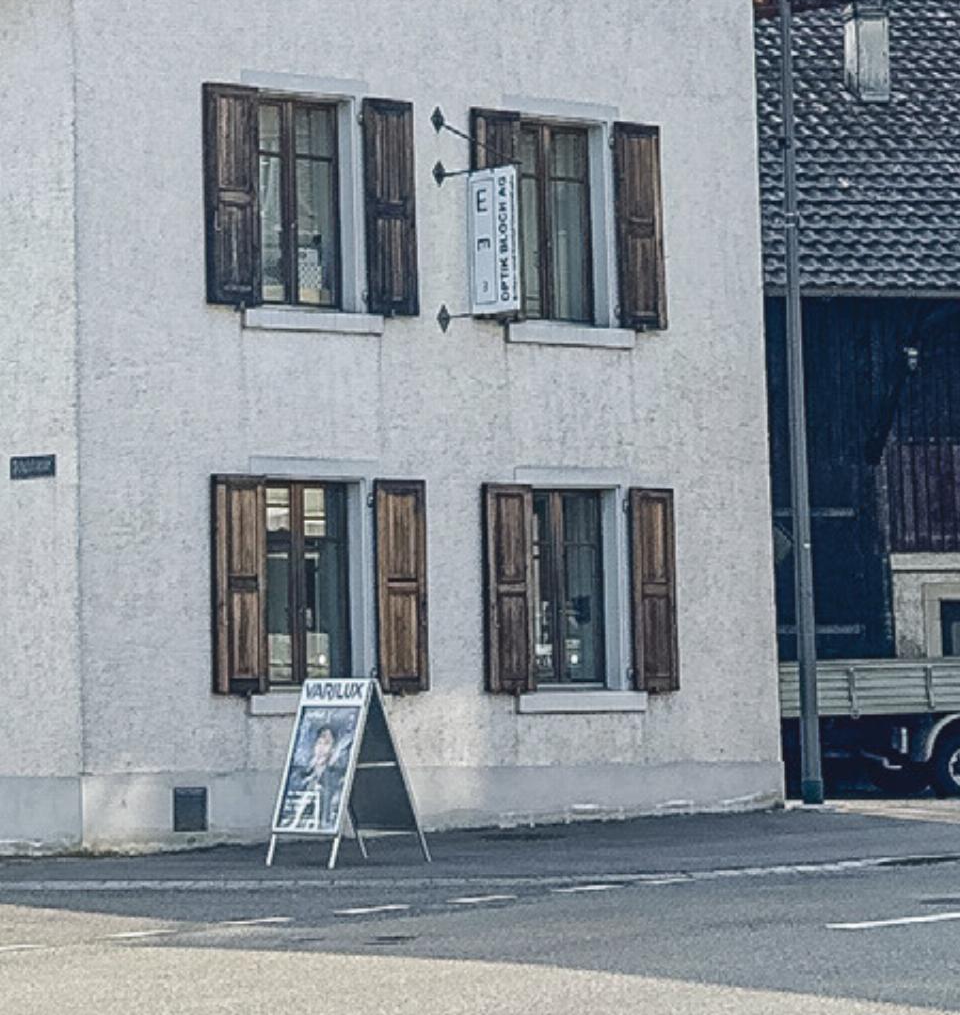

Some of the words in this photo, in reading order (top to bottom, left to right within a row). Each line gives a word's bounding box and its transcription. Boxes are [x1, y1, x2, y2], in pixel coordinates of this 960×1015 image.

[498, 176, 507, 197] AG
[498, 202, 508, 255] BLOCH
[499, 257, 510, 302] OPTIK
[306, 682, 365, 700] VARILUX
